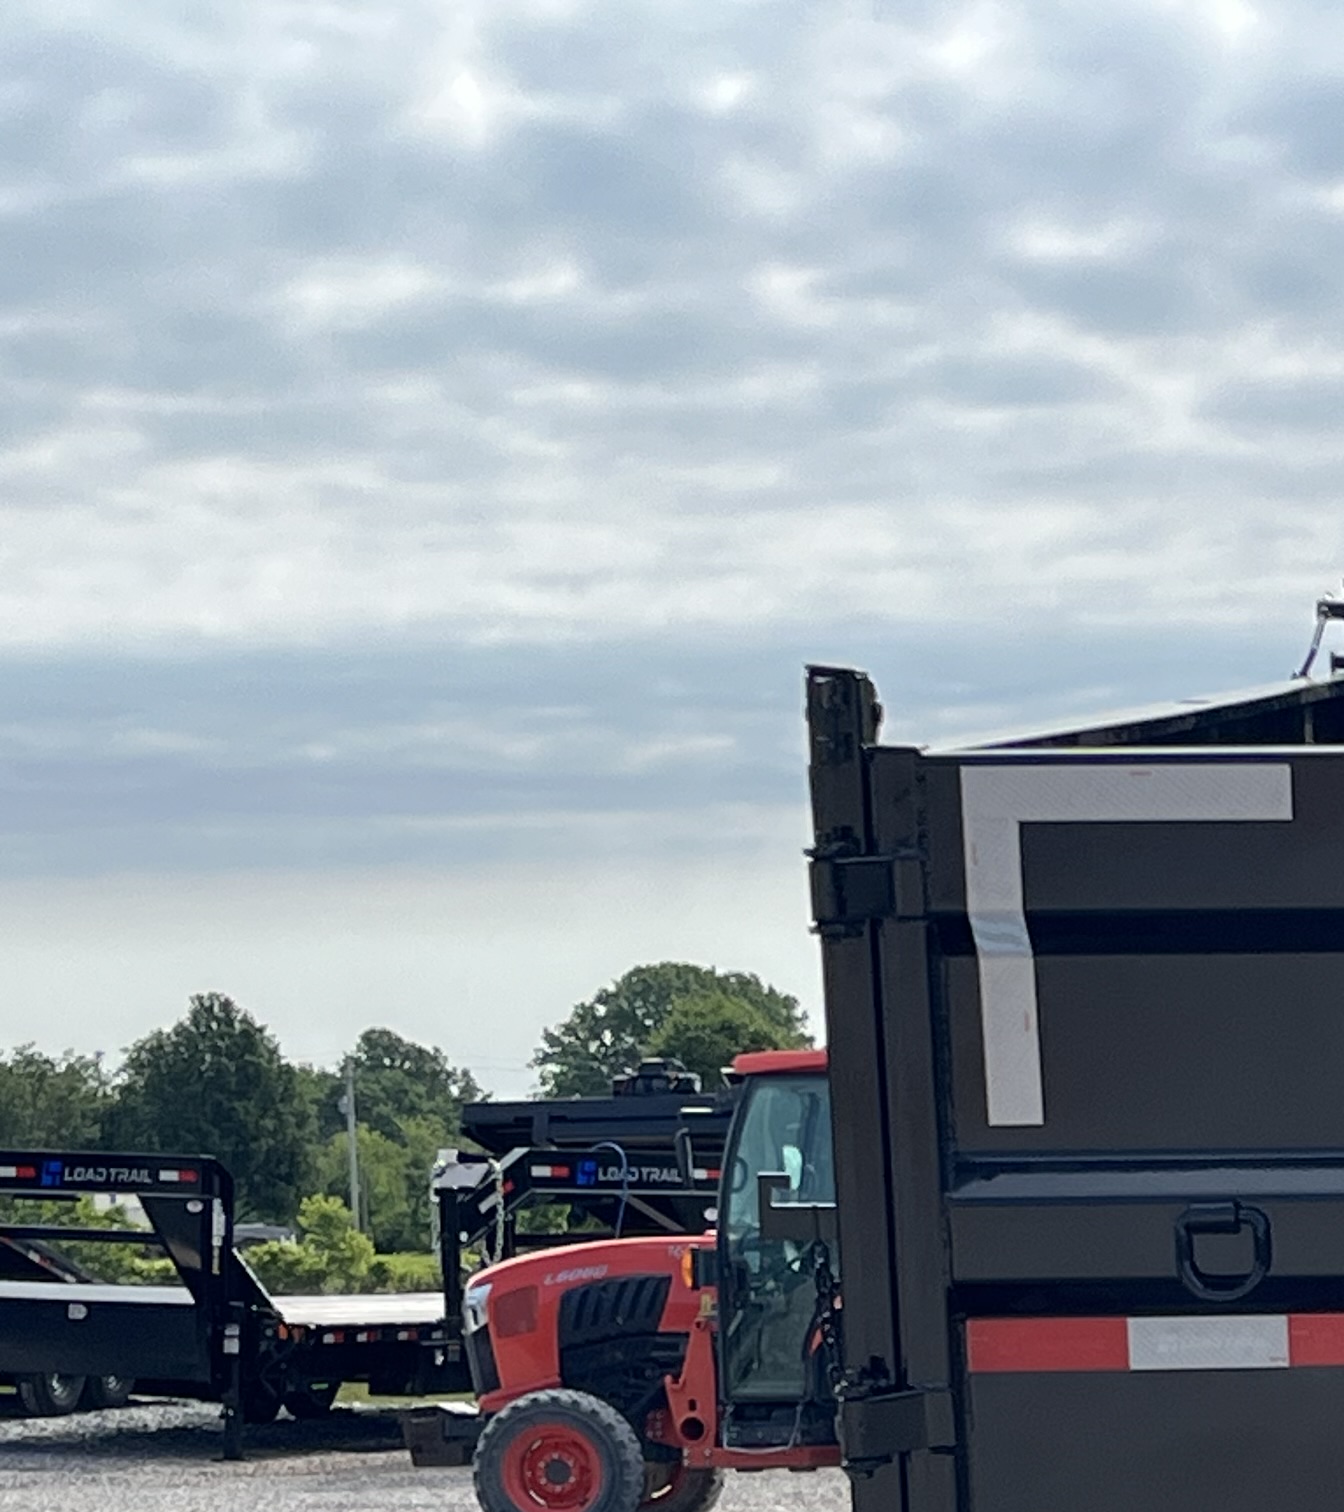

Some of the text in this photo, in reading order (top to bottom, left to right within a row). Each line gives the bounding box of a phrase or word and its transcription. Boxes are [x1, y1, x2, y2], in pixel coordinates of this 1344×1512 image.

[64, 1167, 105, 1182] LOAD
[109, 1168, 152, 1183] TRAIL
[641, 1167, 683, 1183] TRAIL
